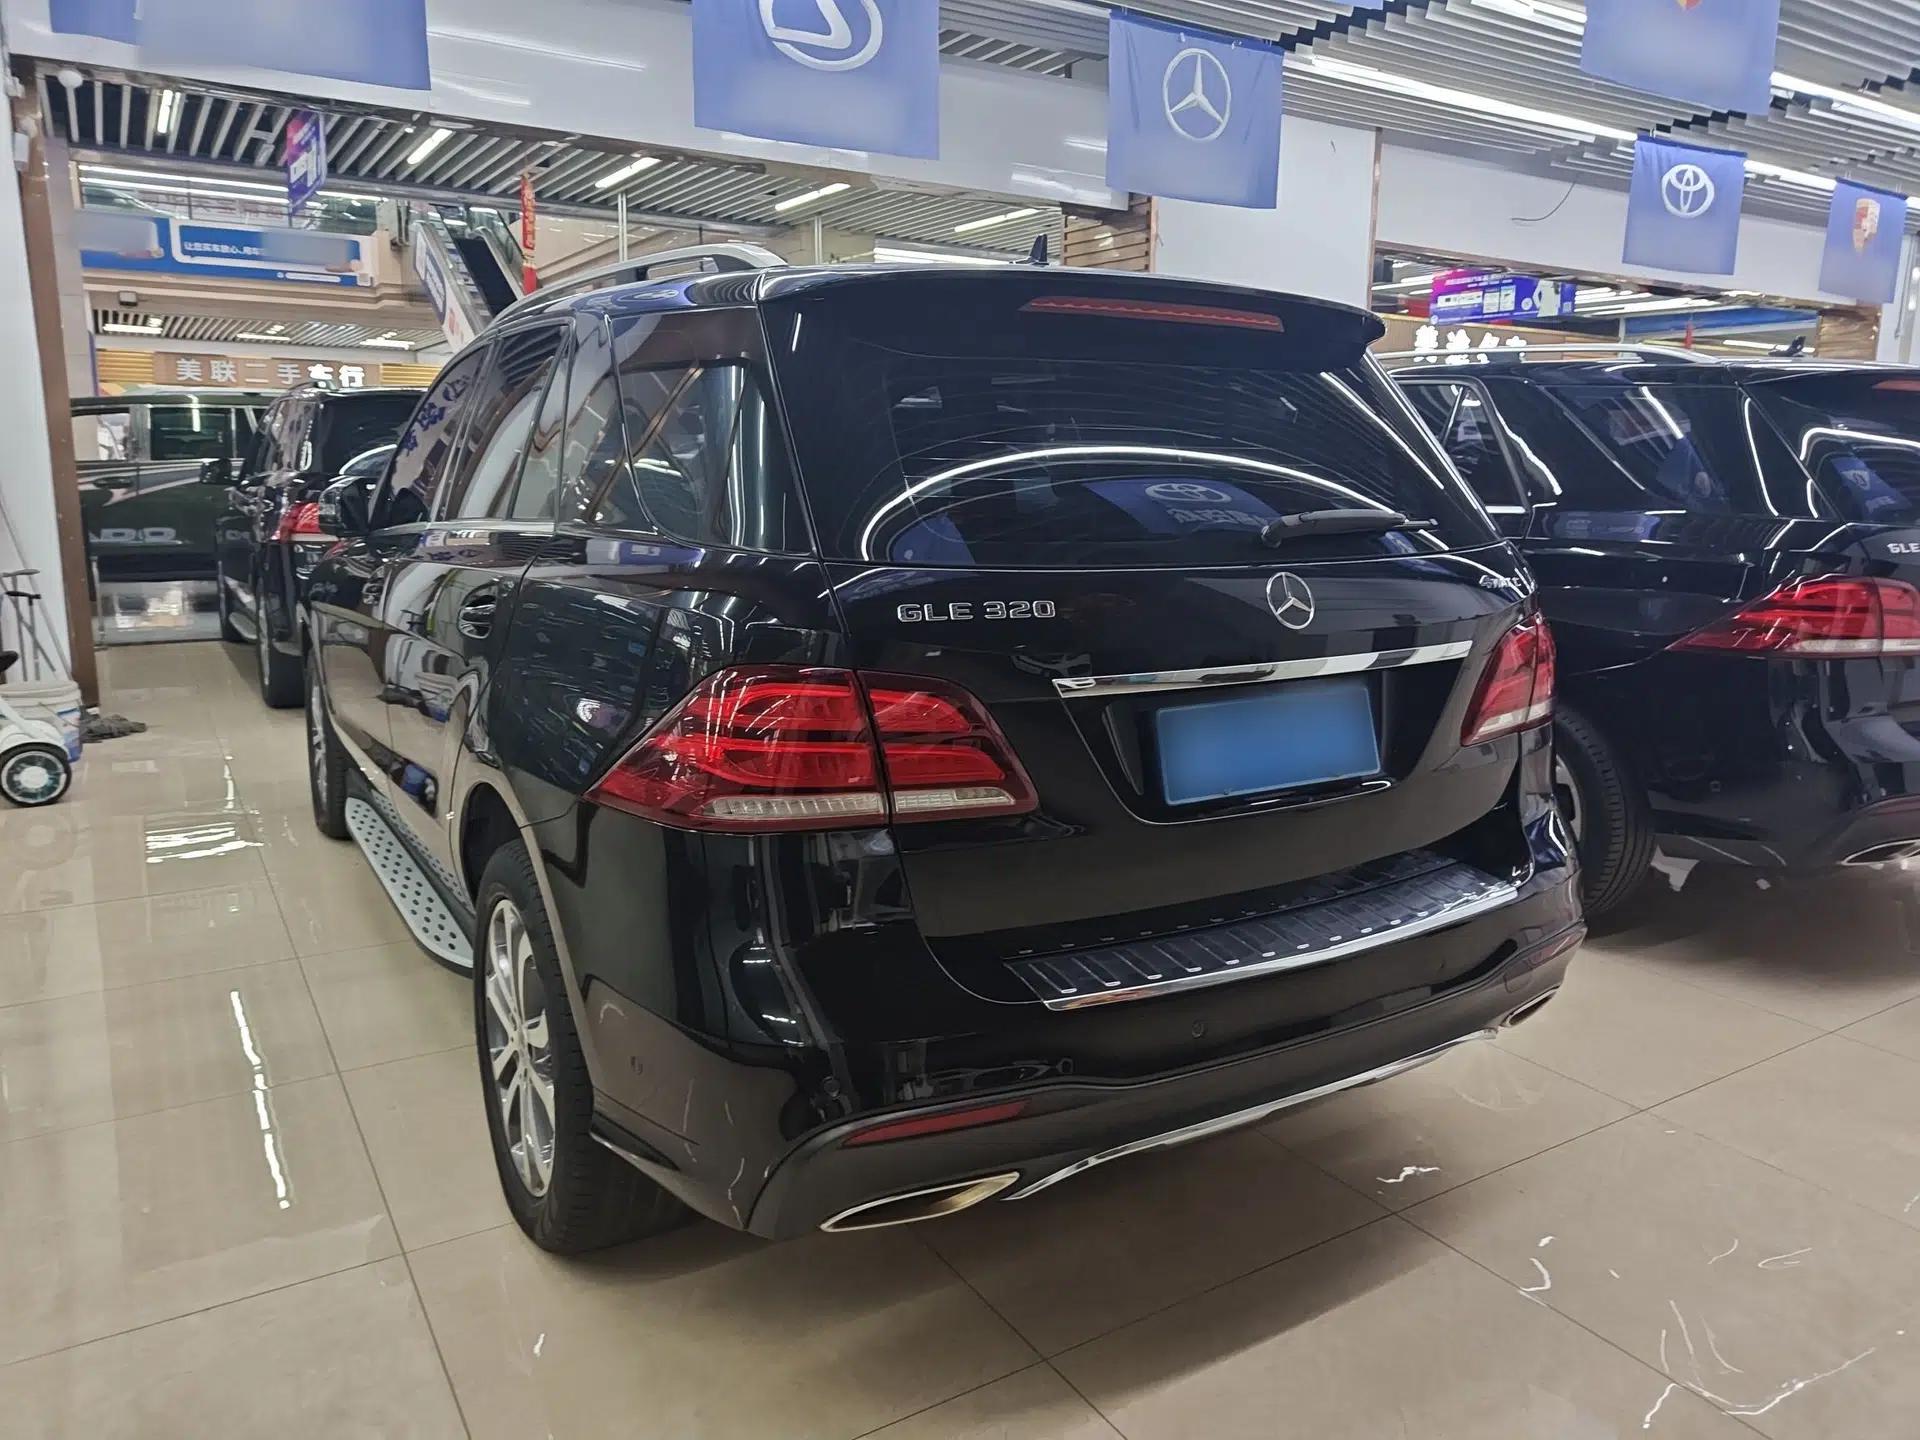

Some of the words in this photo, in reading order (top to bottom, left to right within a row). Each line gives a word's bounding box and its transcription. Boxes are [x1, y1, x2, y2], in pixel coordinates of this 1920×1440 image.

[175, 357, 365, 388] 美联二手车行
[897, 603, 974, 622] GLE
[983, 600, 1056, 619] 320
